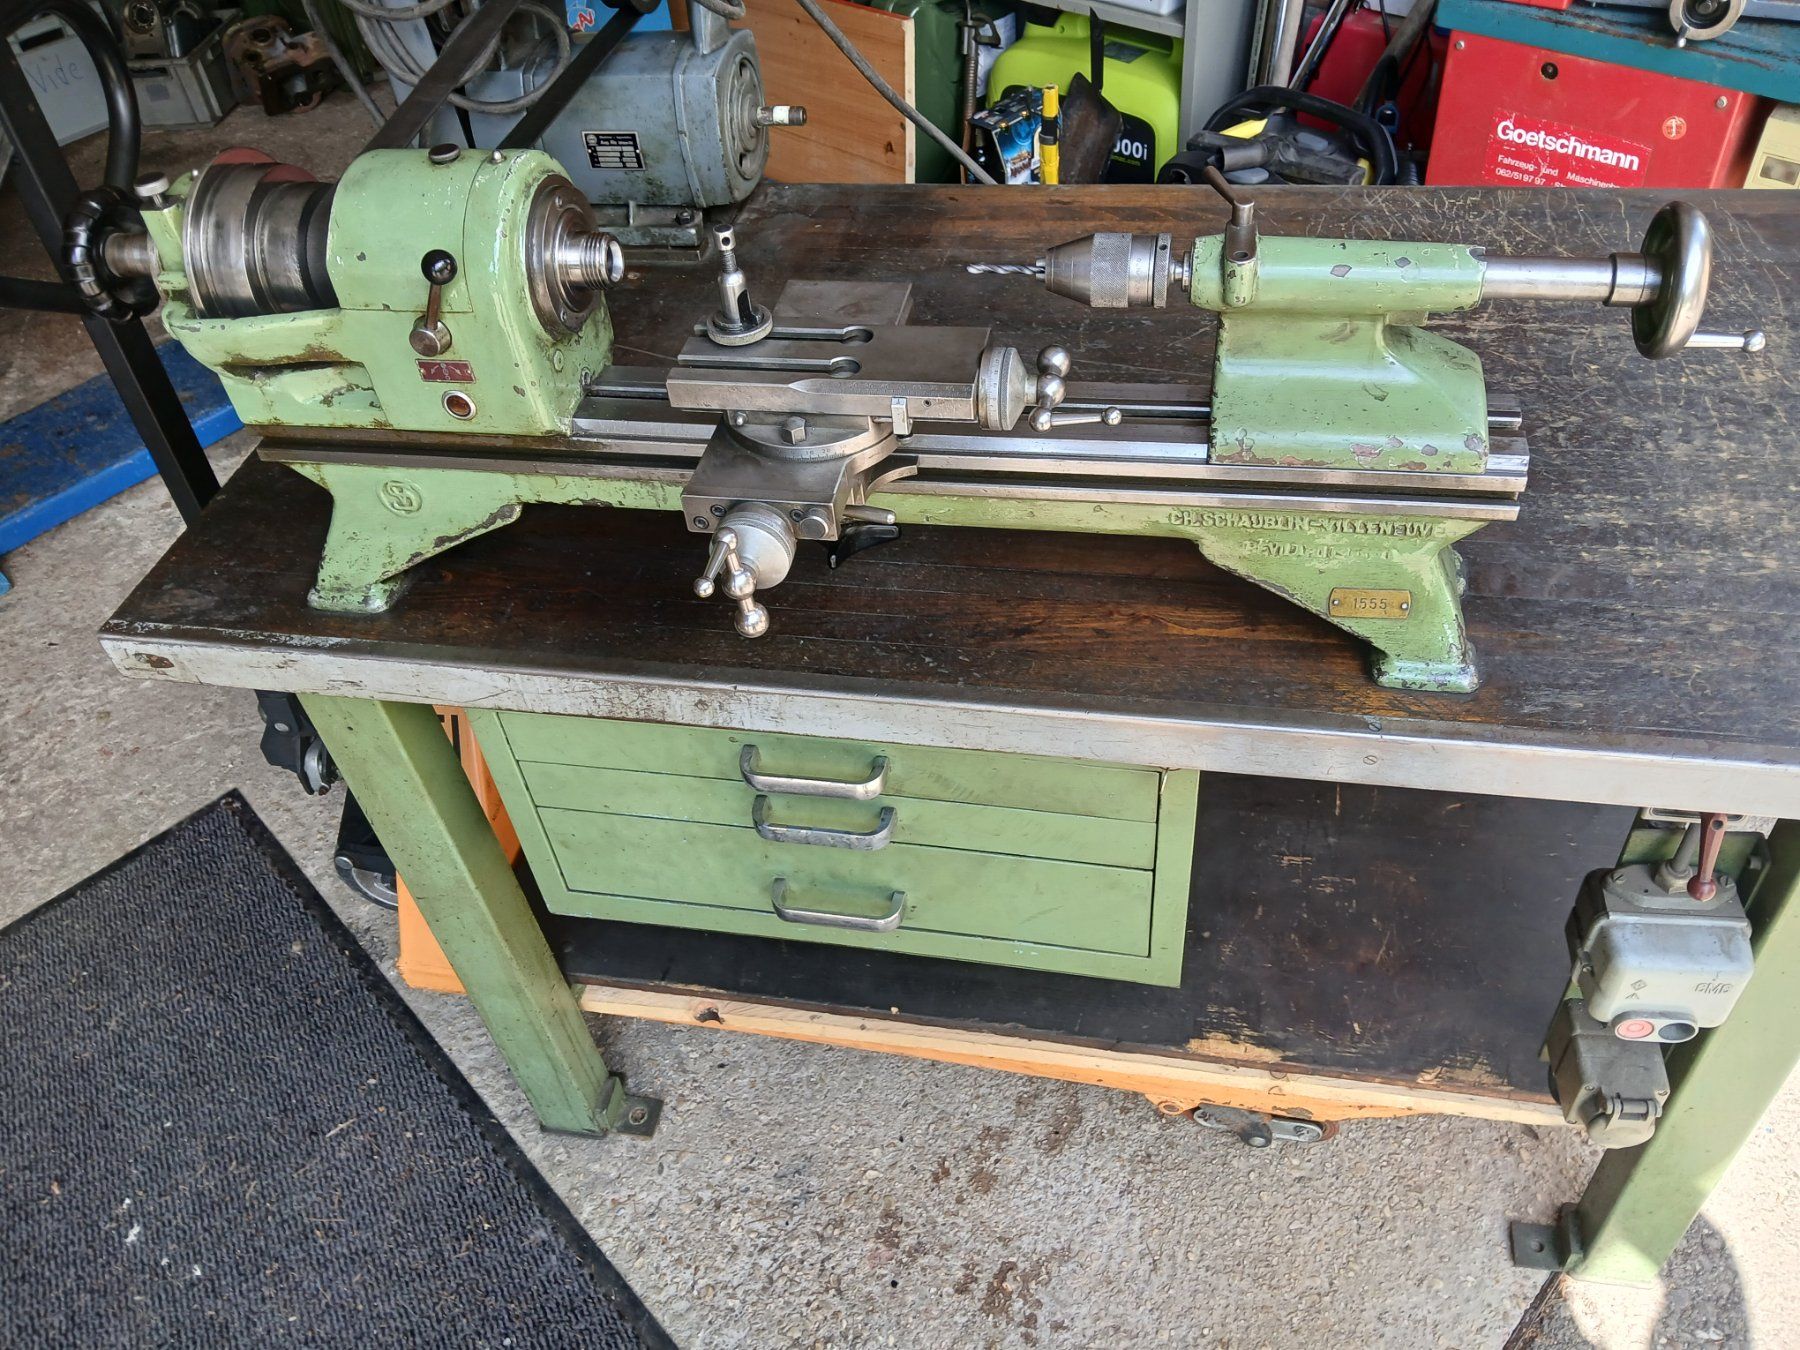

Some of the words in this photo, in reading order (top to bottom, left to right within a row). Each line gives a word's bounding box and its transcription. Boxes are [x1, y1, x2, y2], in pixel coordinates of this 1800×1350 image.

[23, 53, 84, 93] Vide
[1496, 120, 1640, 171] Goetschmann
[1497, 154, 1538, 172] Fahrzeug-
[1542, 164, 1559, 177] und
[1352, 597, 1388, 611] 1555
